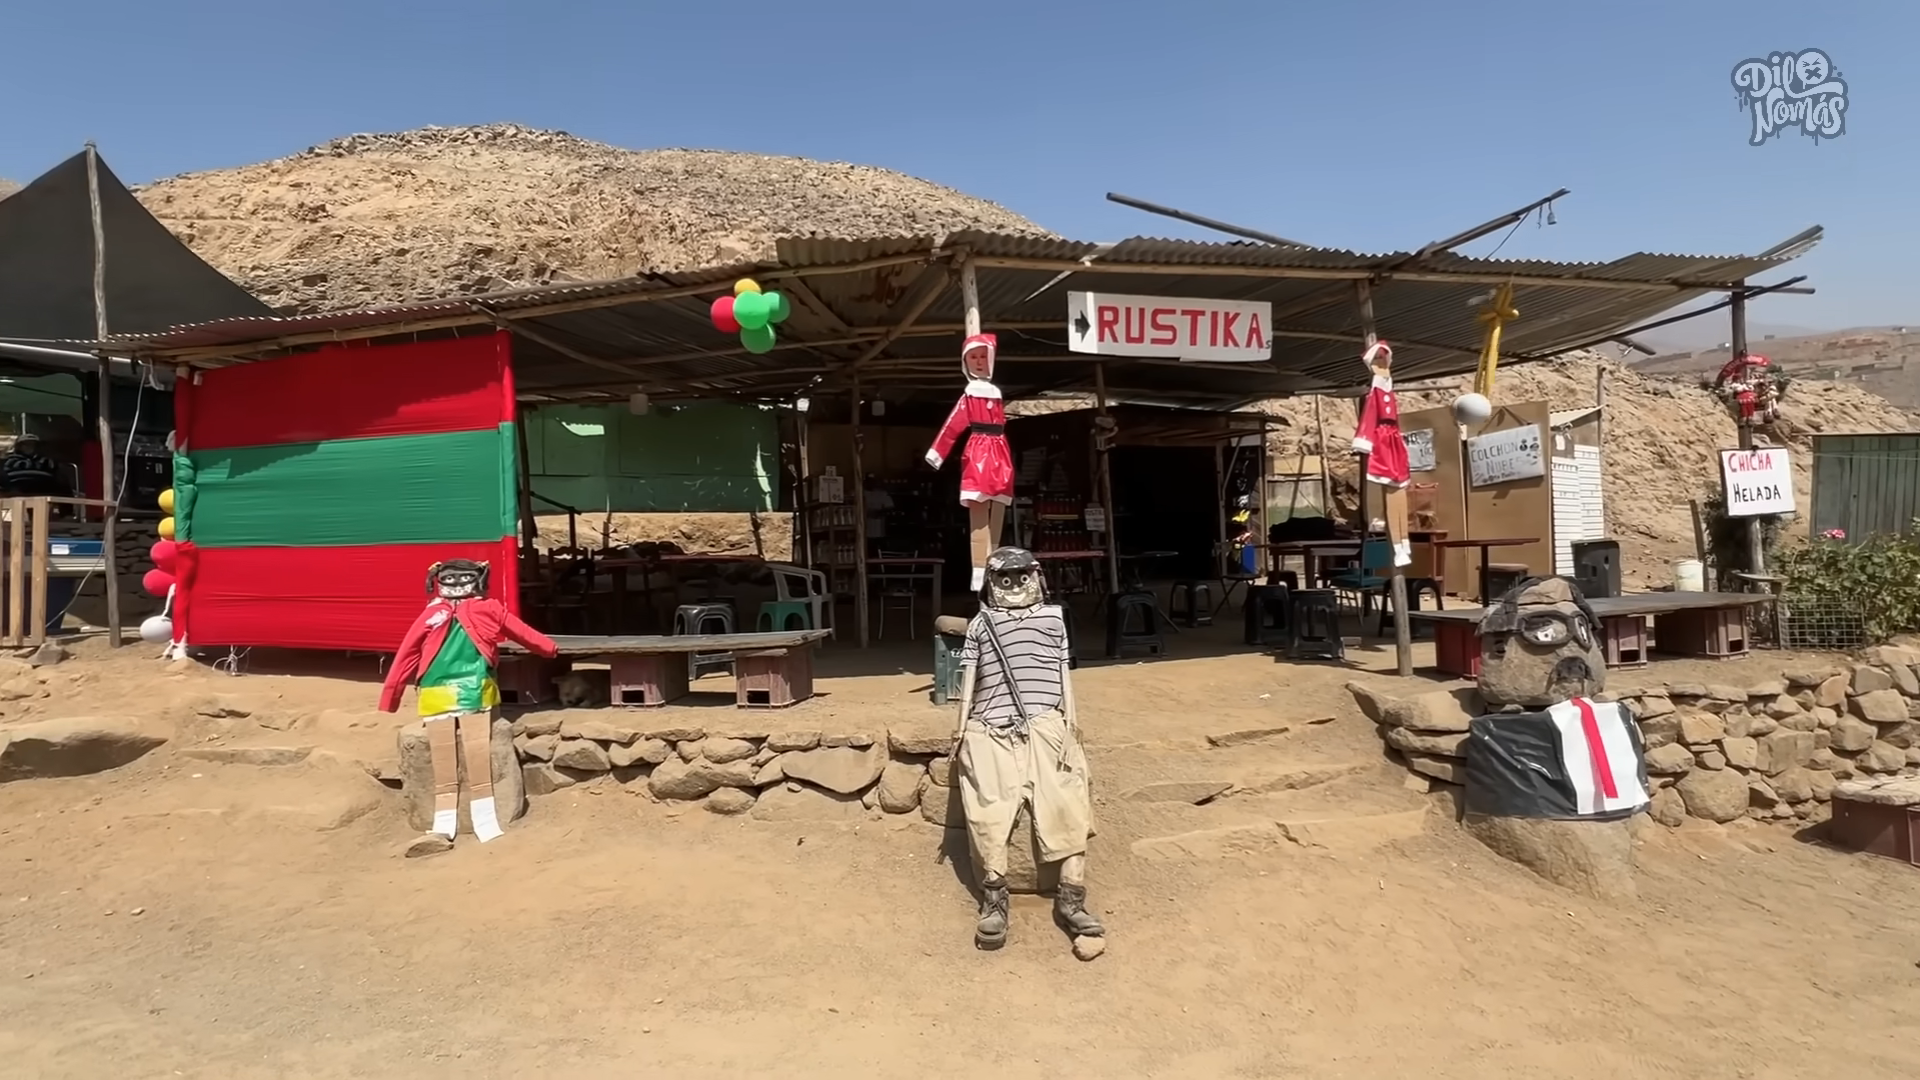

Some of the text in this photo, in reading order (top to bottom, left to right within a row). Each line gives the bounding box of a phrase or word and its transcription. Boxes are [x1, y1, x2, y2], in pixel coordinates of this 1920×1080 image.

[1097, 305, 1264, 348] RUSTIKA
[1728, 453, 1773, 473] CHICHA
[1733, 483, 1781, 503] HELADA
